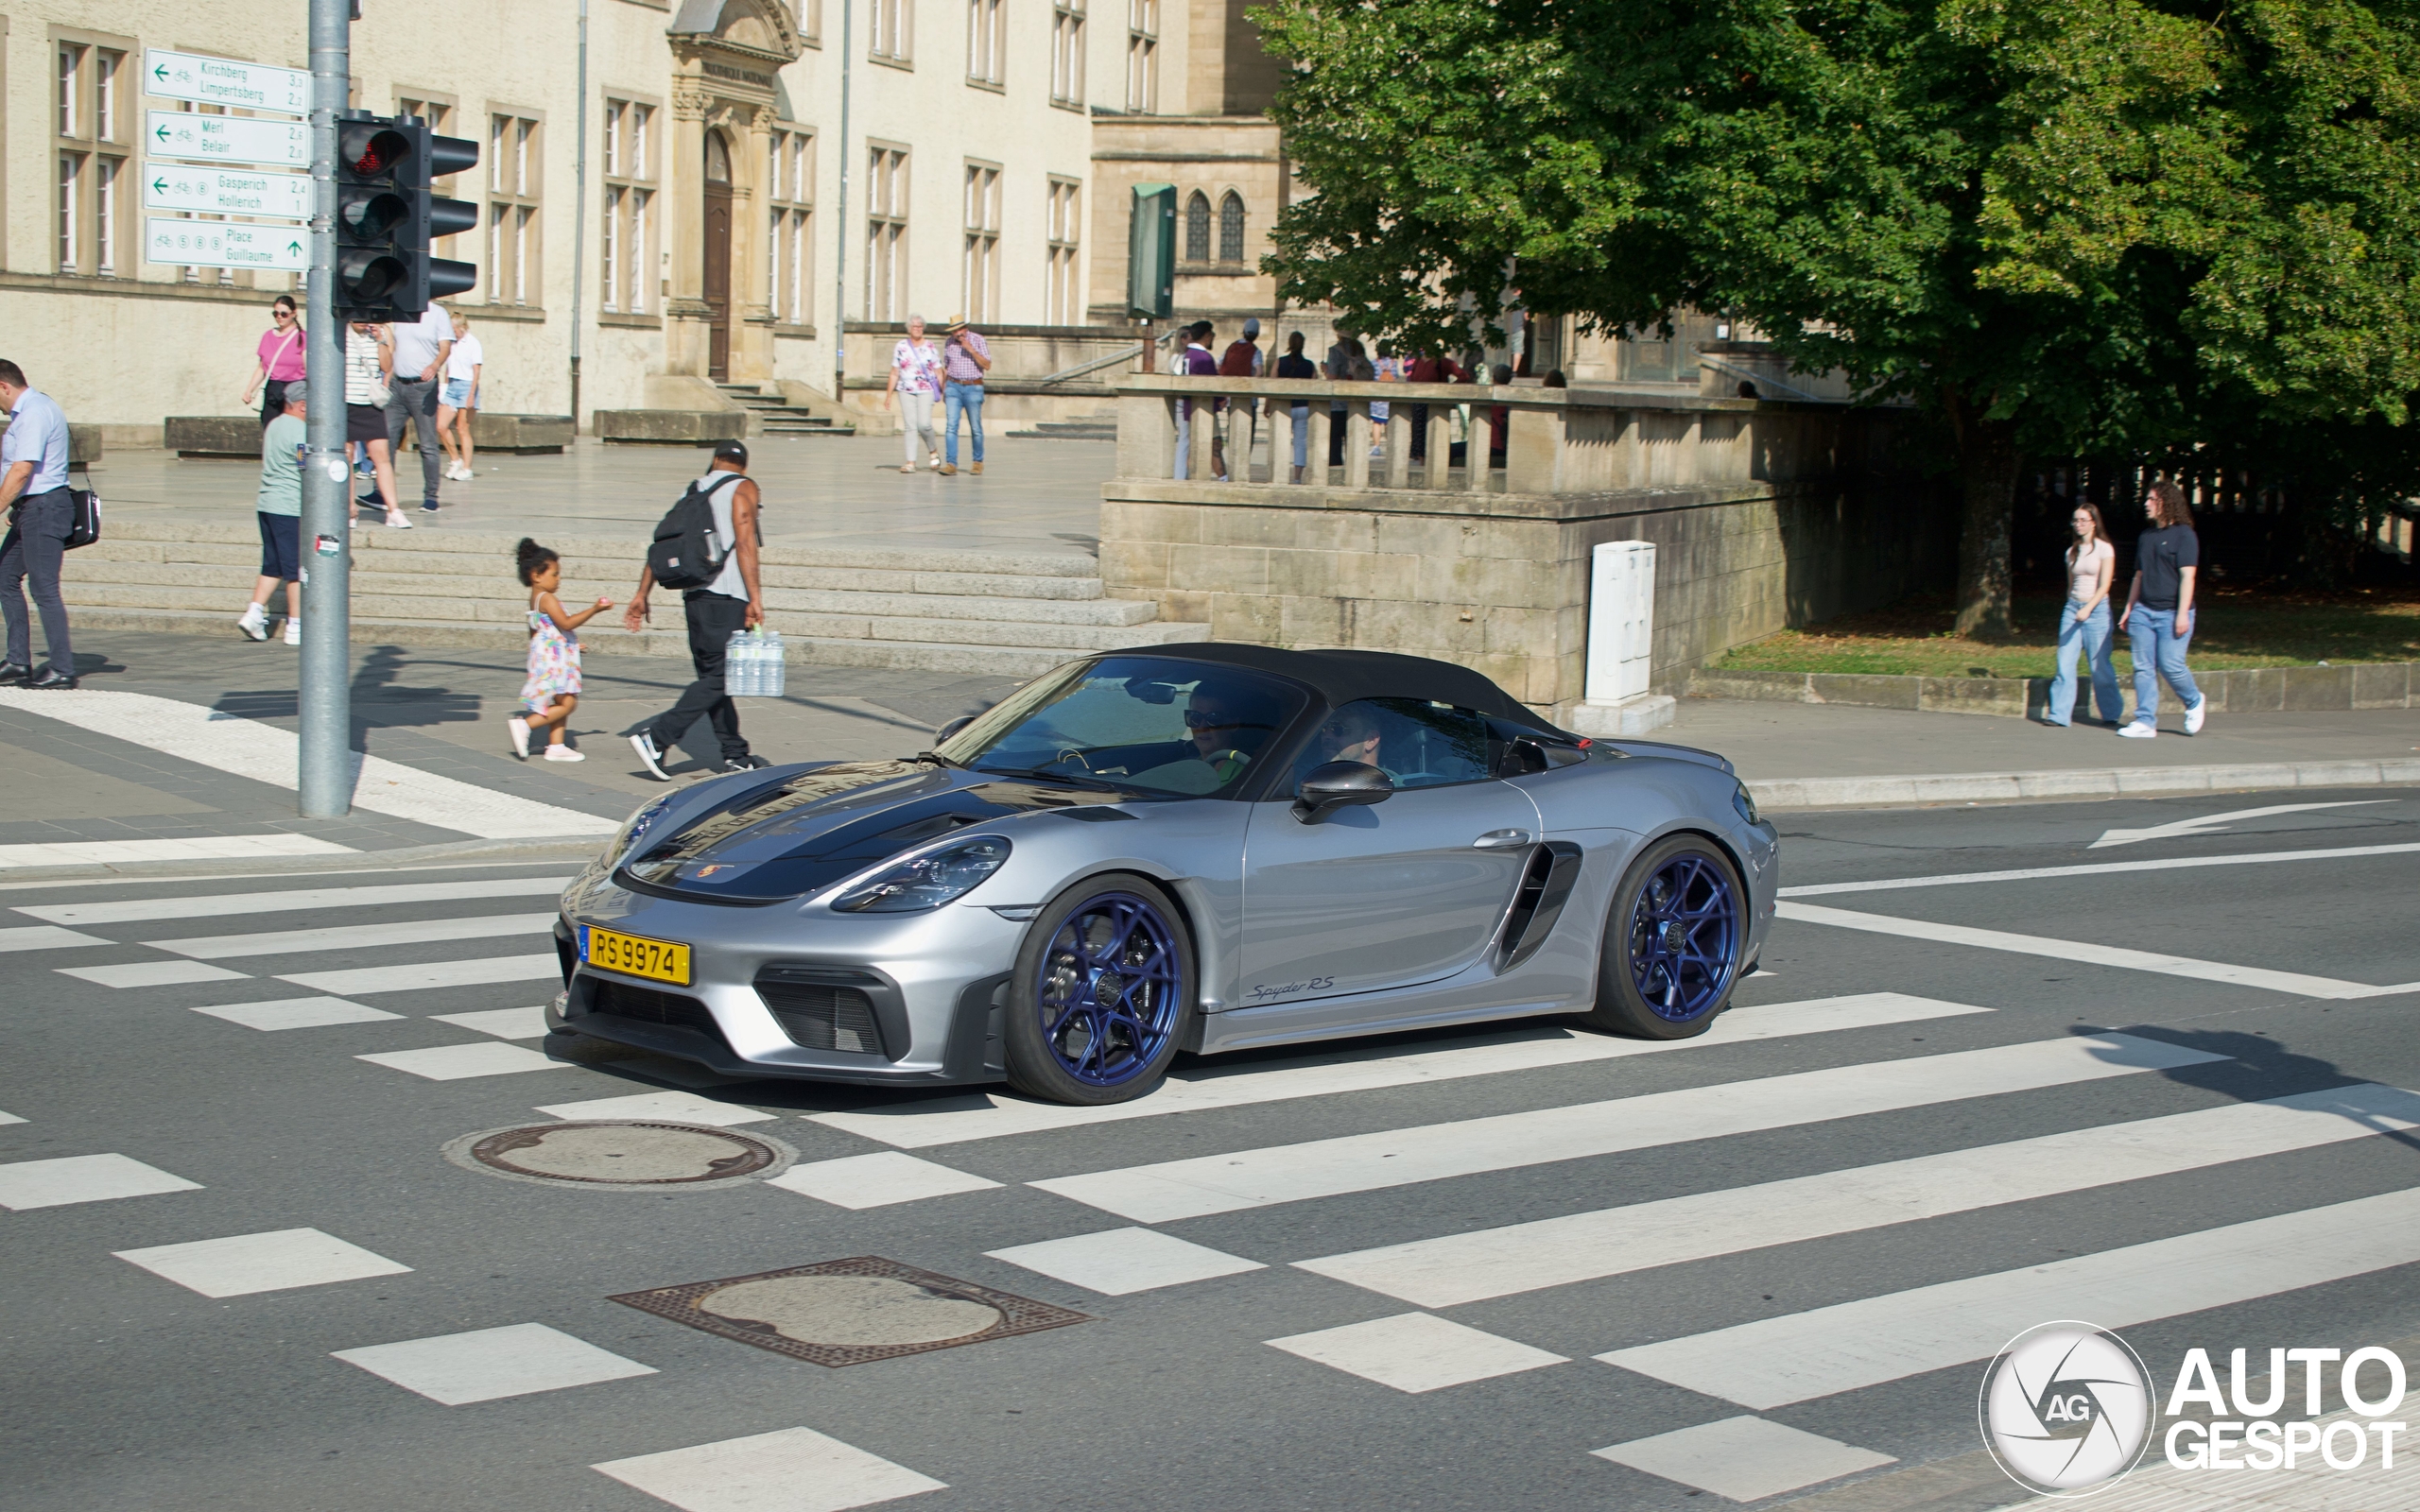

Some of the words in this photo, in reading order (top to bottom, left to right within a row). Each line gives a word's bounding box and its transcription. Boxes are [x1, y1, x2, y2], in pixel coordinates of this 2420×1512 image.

[200, 61, 248, 83] Kirchberg
[288, 74, 303, 88] 3,3
[199, 79, 265, 104] Limpertsberg
[287, 92, 302, 107] 2,2
[201, 120, 223, 134] Merl
[201, 139, 231, 153] Belair
[218, 175, 268, 192] Gasperich
[290, 180, 306, 195] 2,4
[217, 194, 262, 209] Hollerich
[295, 199, 301, 213] 1
[226, 229, 253, 243] Place
[226, 247, 274, 263] Guillaume
[596, 933, 618, 964] RS
[623, 940, 675, 976] 9974
[1246, 982, 1306, 1000] Spyder
[1307, 976, 1335, 991] RS
